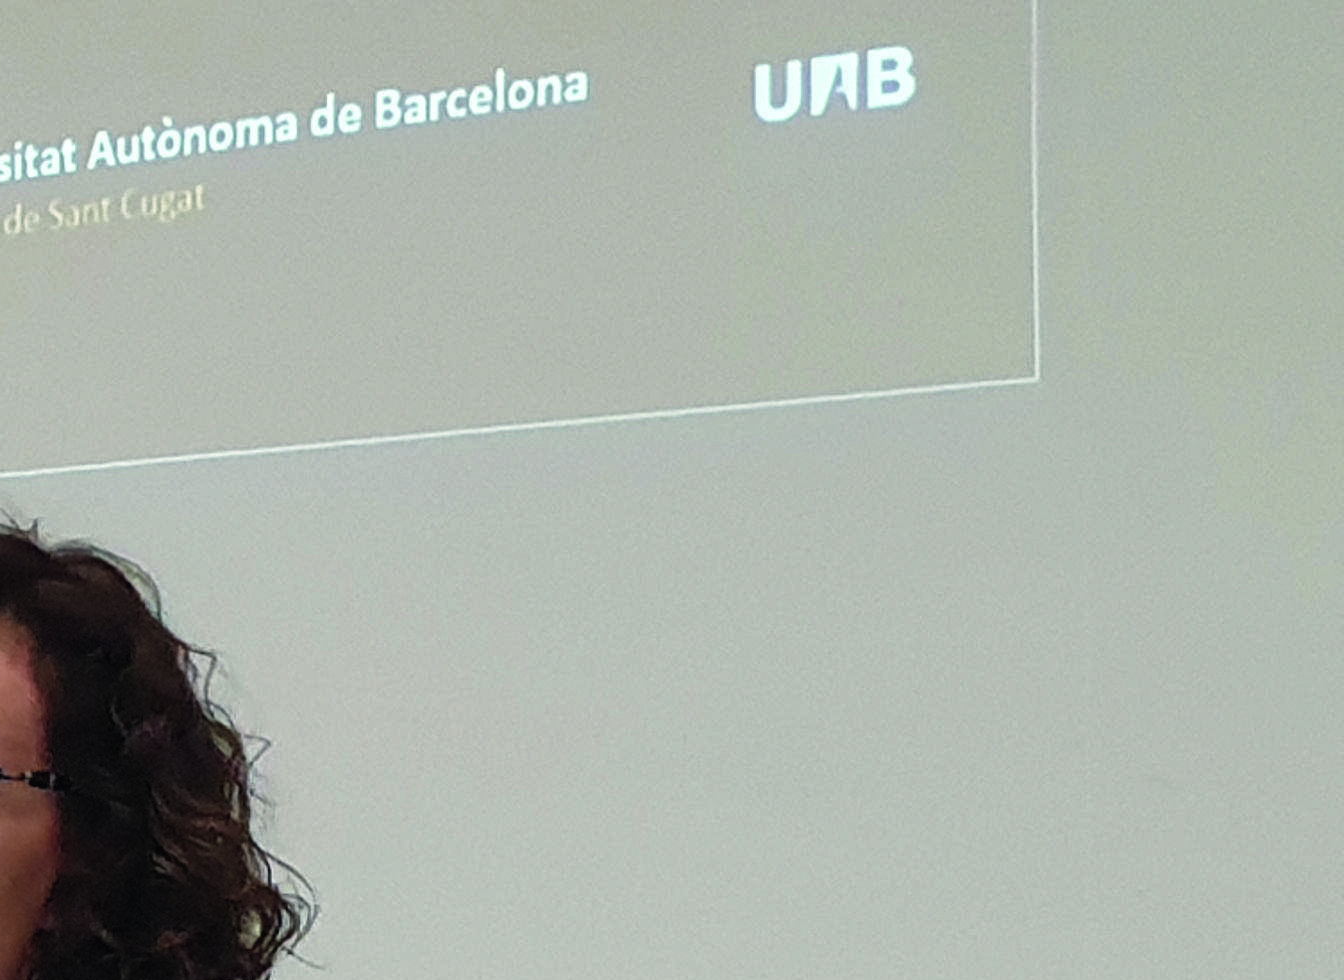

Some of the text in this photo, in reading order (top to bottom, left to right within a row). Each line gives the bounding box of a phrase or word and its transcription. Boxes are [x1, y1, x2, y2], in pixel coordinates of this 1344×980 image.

[87, 115, 298, 170] Autònoma
[311, 92, 363, 136] de
[375, 67, 589, 129] Barcelona
[754, 46, 916, 122] UAB
[3, 203, 40, 236] de
[48, 197, 113, 230] Sant
[120, 184, 206, 222] Cugat
